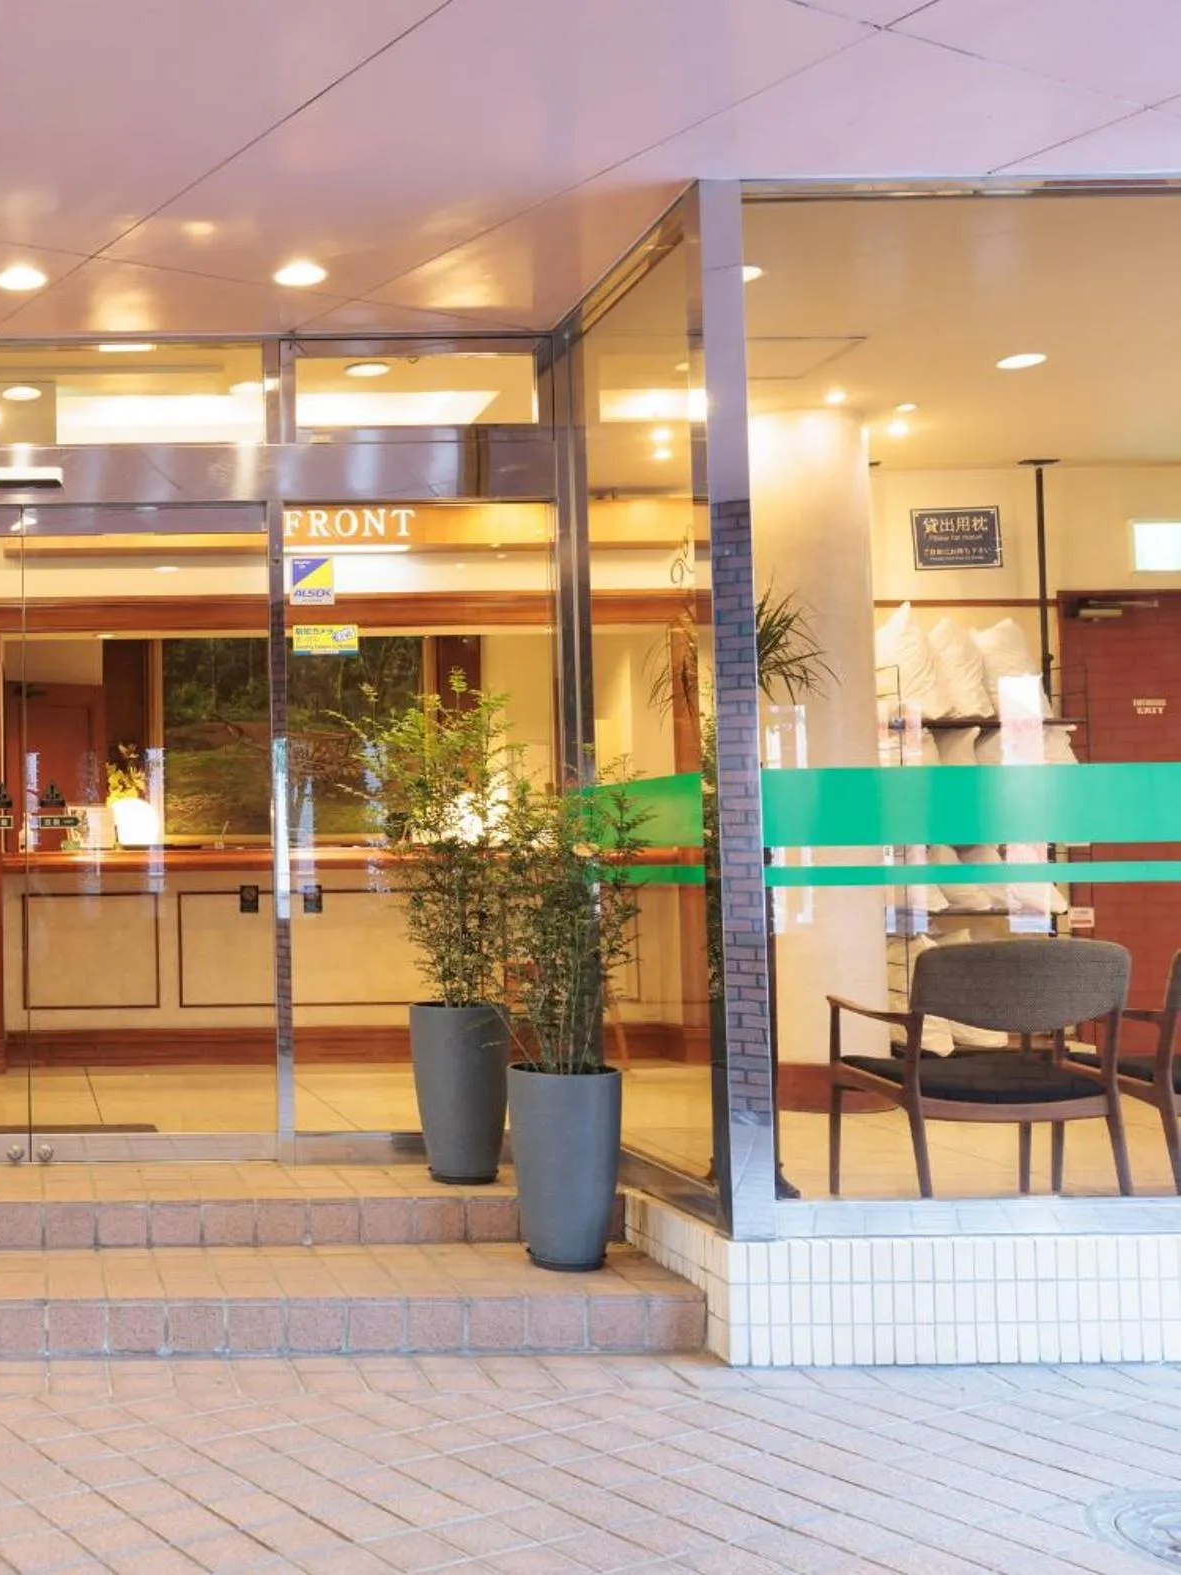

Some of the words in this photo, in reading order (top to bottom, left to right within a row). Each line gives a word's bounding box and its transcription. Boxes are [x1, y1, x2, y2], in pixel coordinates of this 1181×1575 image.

[283, 508, 416, 537] FRONT
[922, 516, 989, 533] 貸出用枕
[293, 588, 332, 598] ALSOK
